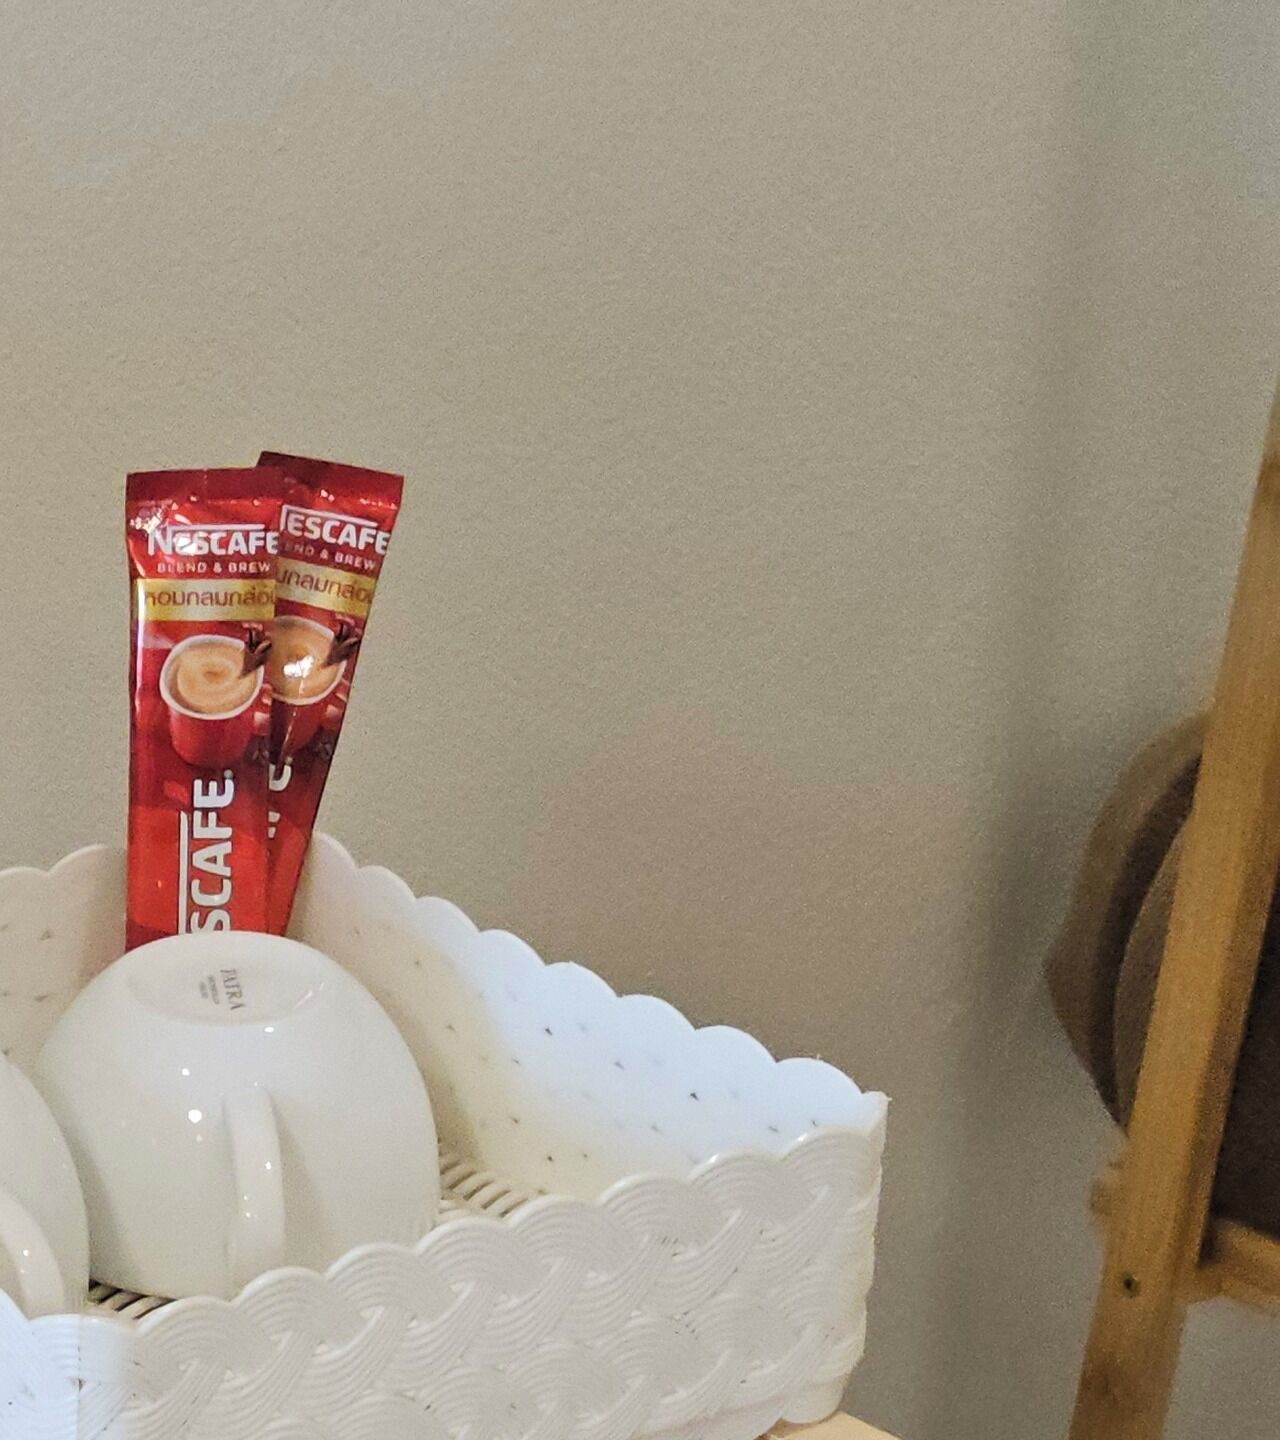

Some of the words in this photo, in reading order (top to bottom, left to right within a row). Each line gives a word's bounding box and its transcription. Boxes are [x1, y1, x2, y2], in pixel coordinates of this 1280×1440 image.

[156, 561, 208, 574] BLEND
[212, 561, 223, 574] &
[228, 561, 272, 574] BREW
[334, 551, 376, 571] BREW
